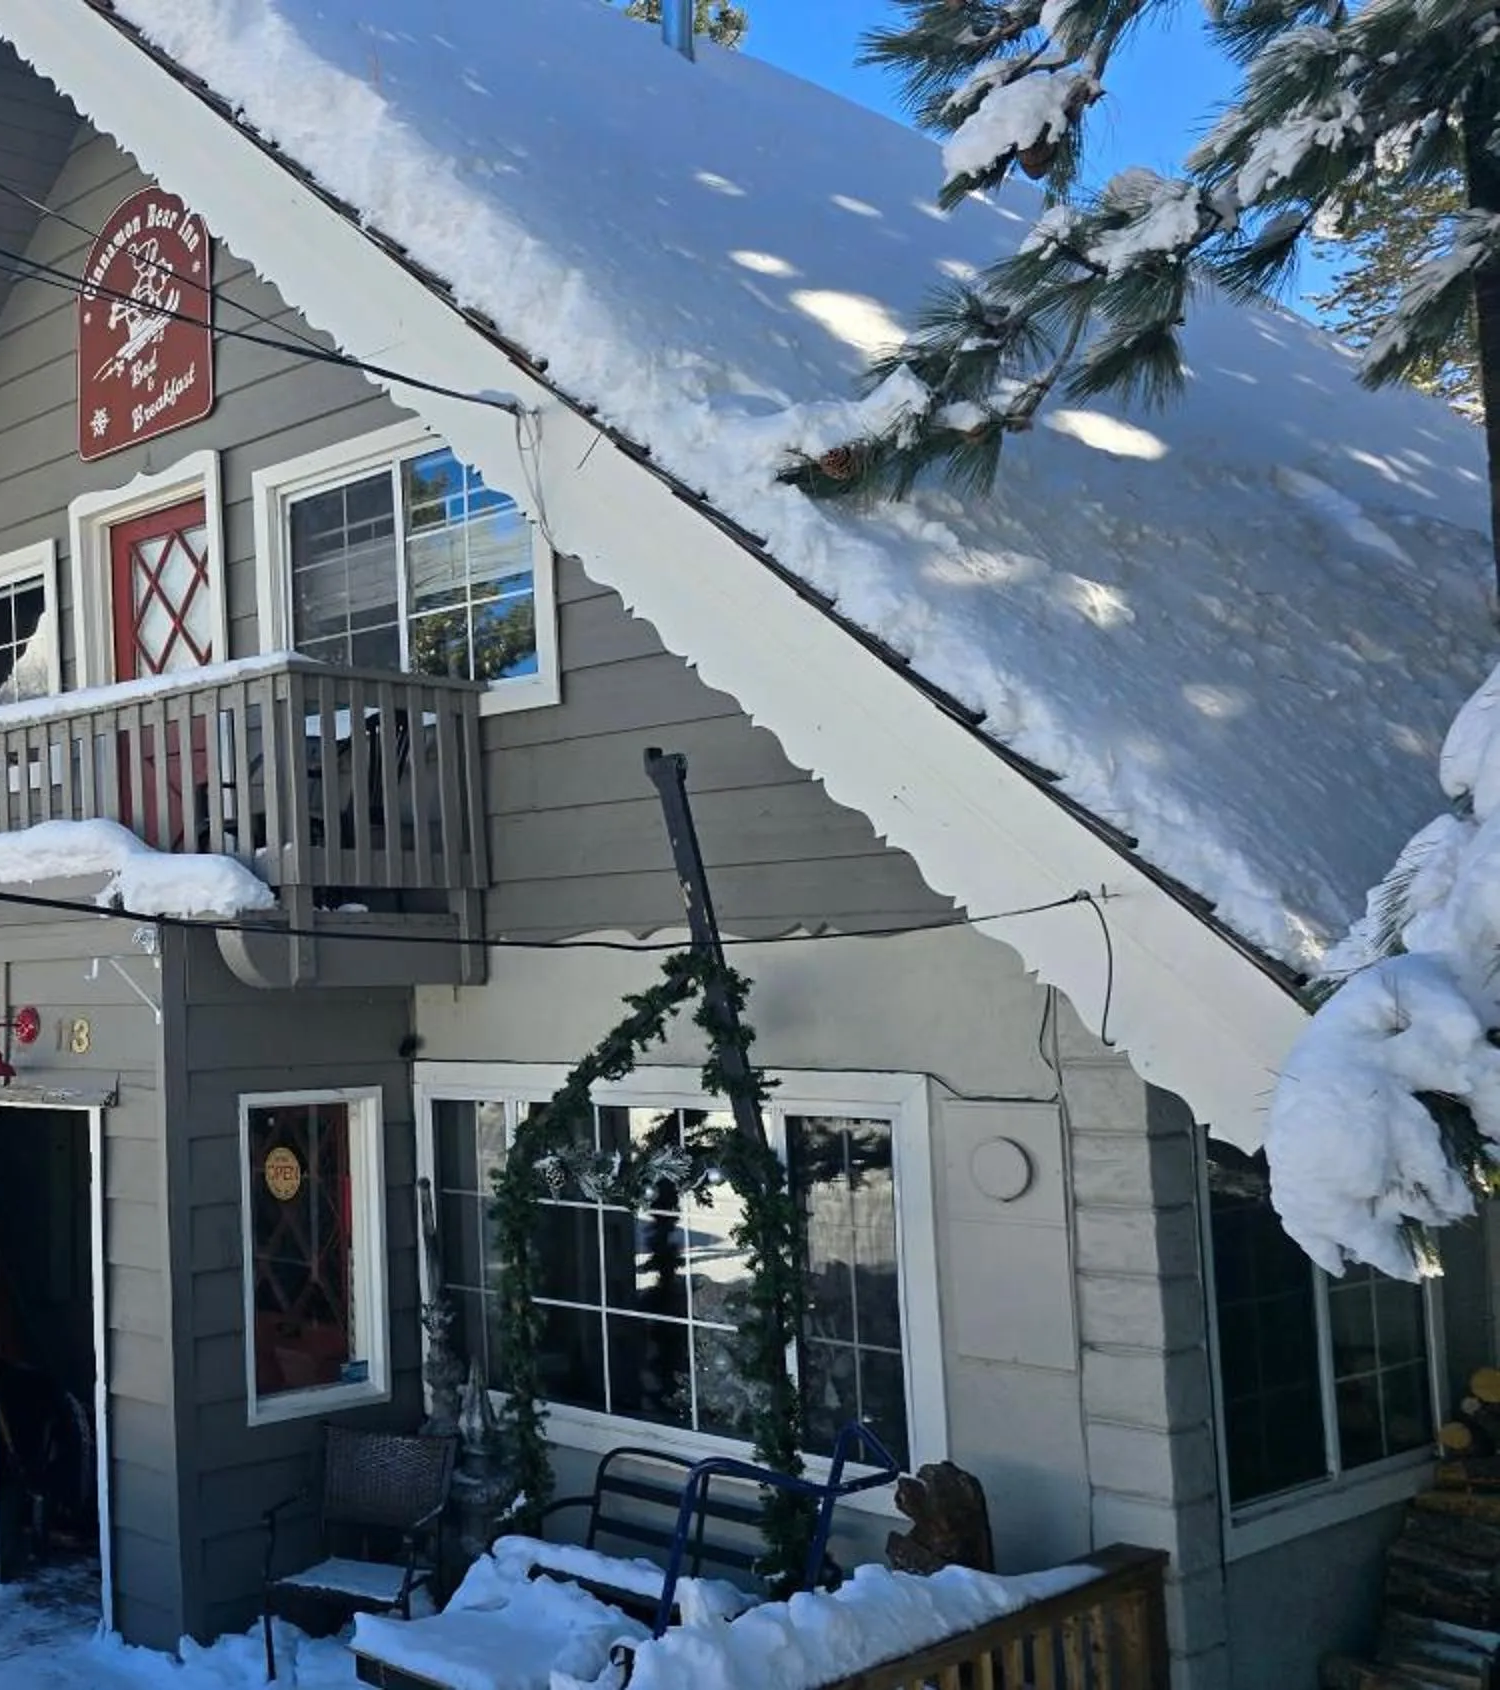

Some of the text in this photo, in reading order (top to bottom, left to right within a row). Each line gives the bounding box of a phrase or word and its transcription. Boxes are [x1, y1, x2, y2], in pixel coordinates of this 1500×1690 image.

[83, 203, 200, 301] Cinnamon Bear Inn
[130, 347, 157, 388] Bed
[131, 360, 196, 433] Breakfast
